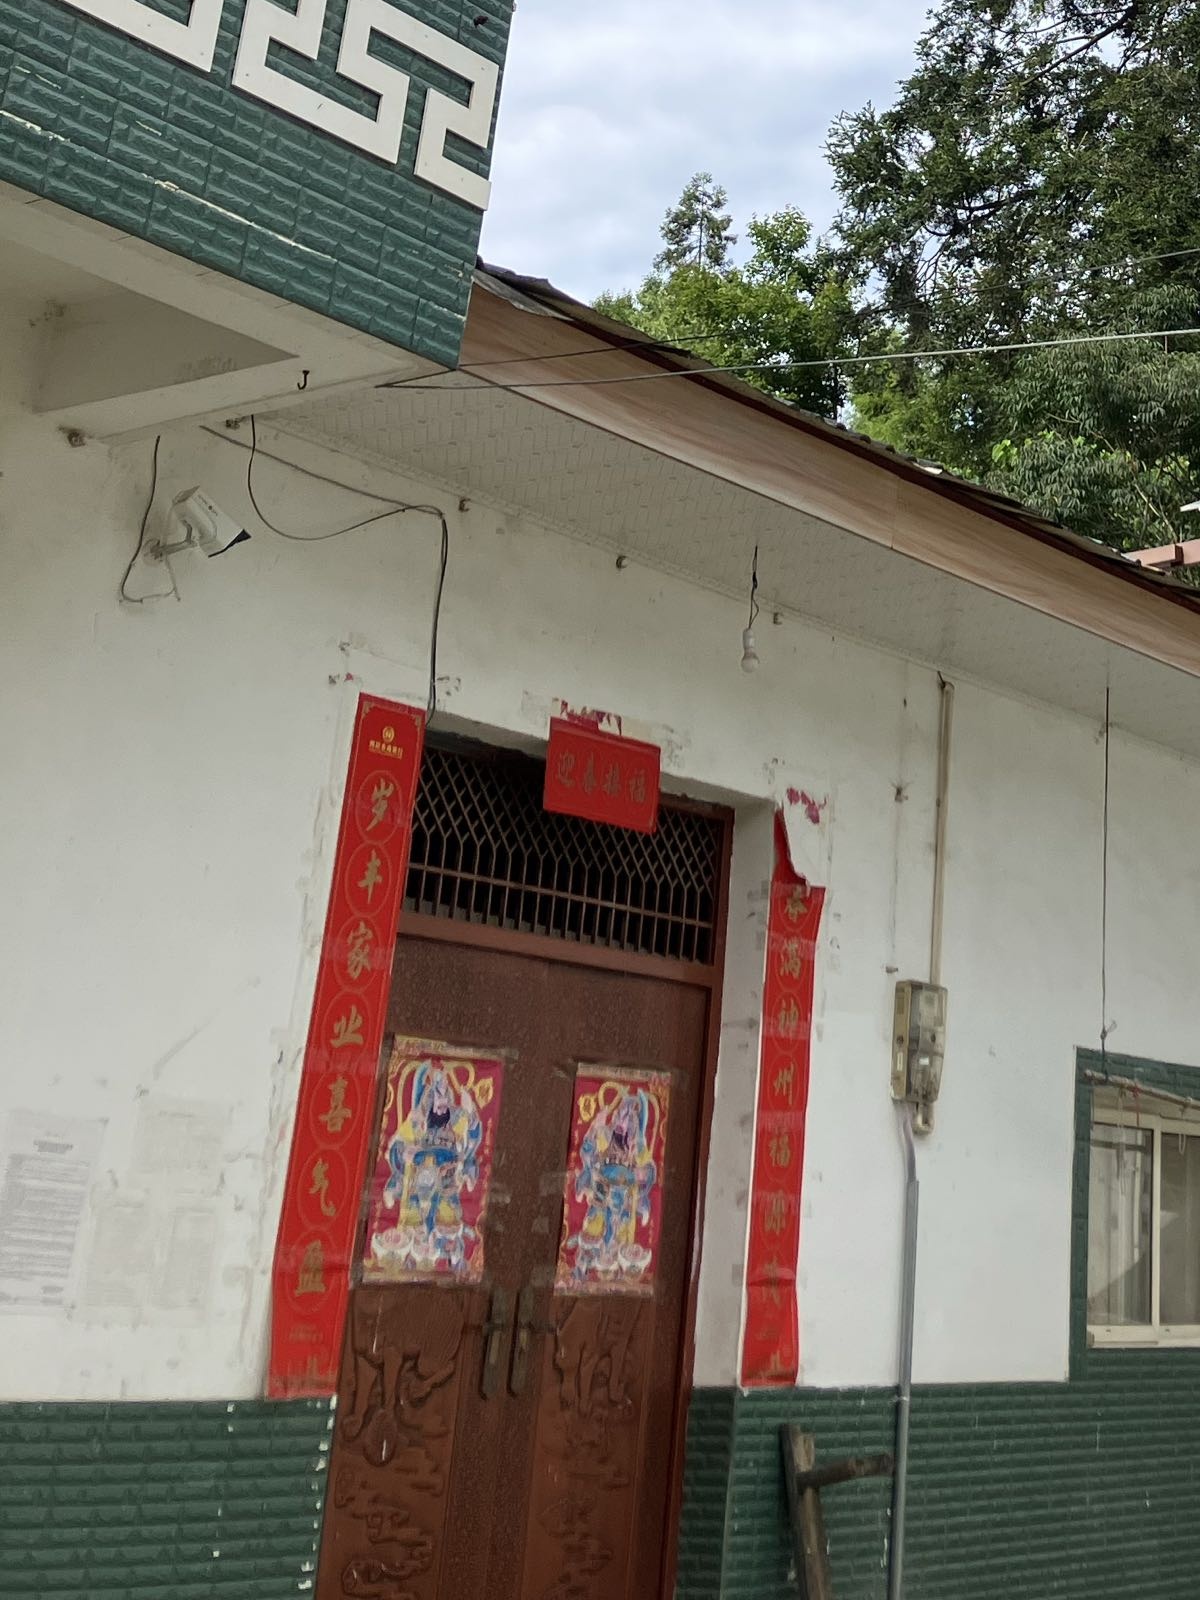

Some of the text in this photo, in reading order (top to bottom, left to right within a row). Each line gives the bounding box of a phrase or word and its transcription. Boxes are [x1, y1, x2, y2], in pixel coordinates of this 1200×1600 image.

[294, 776, 396, 1297] 岁丰家业喜气盈
